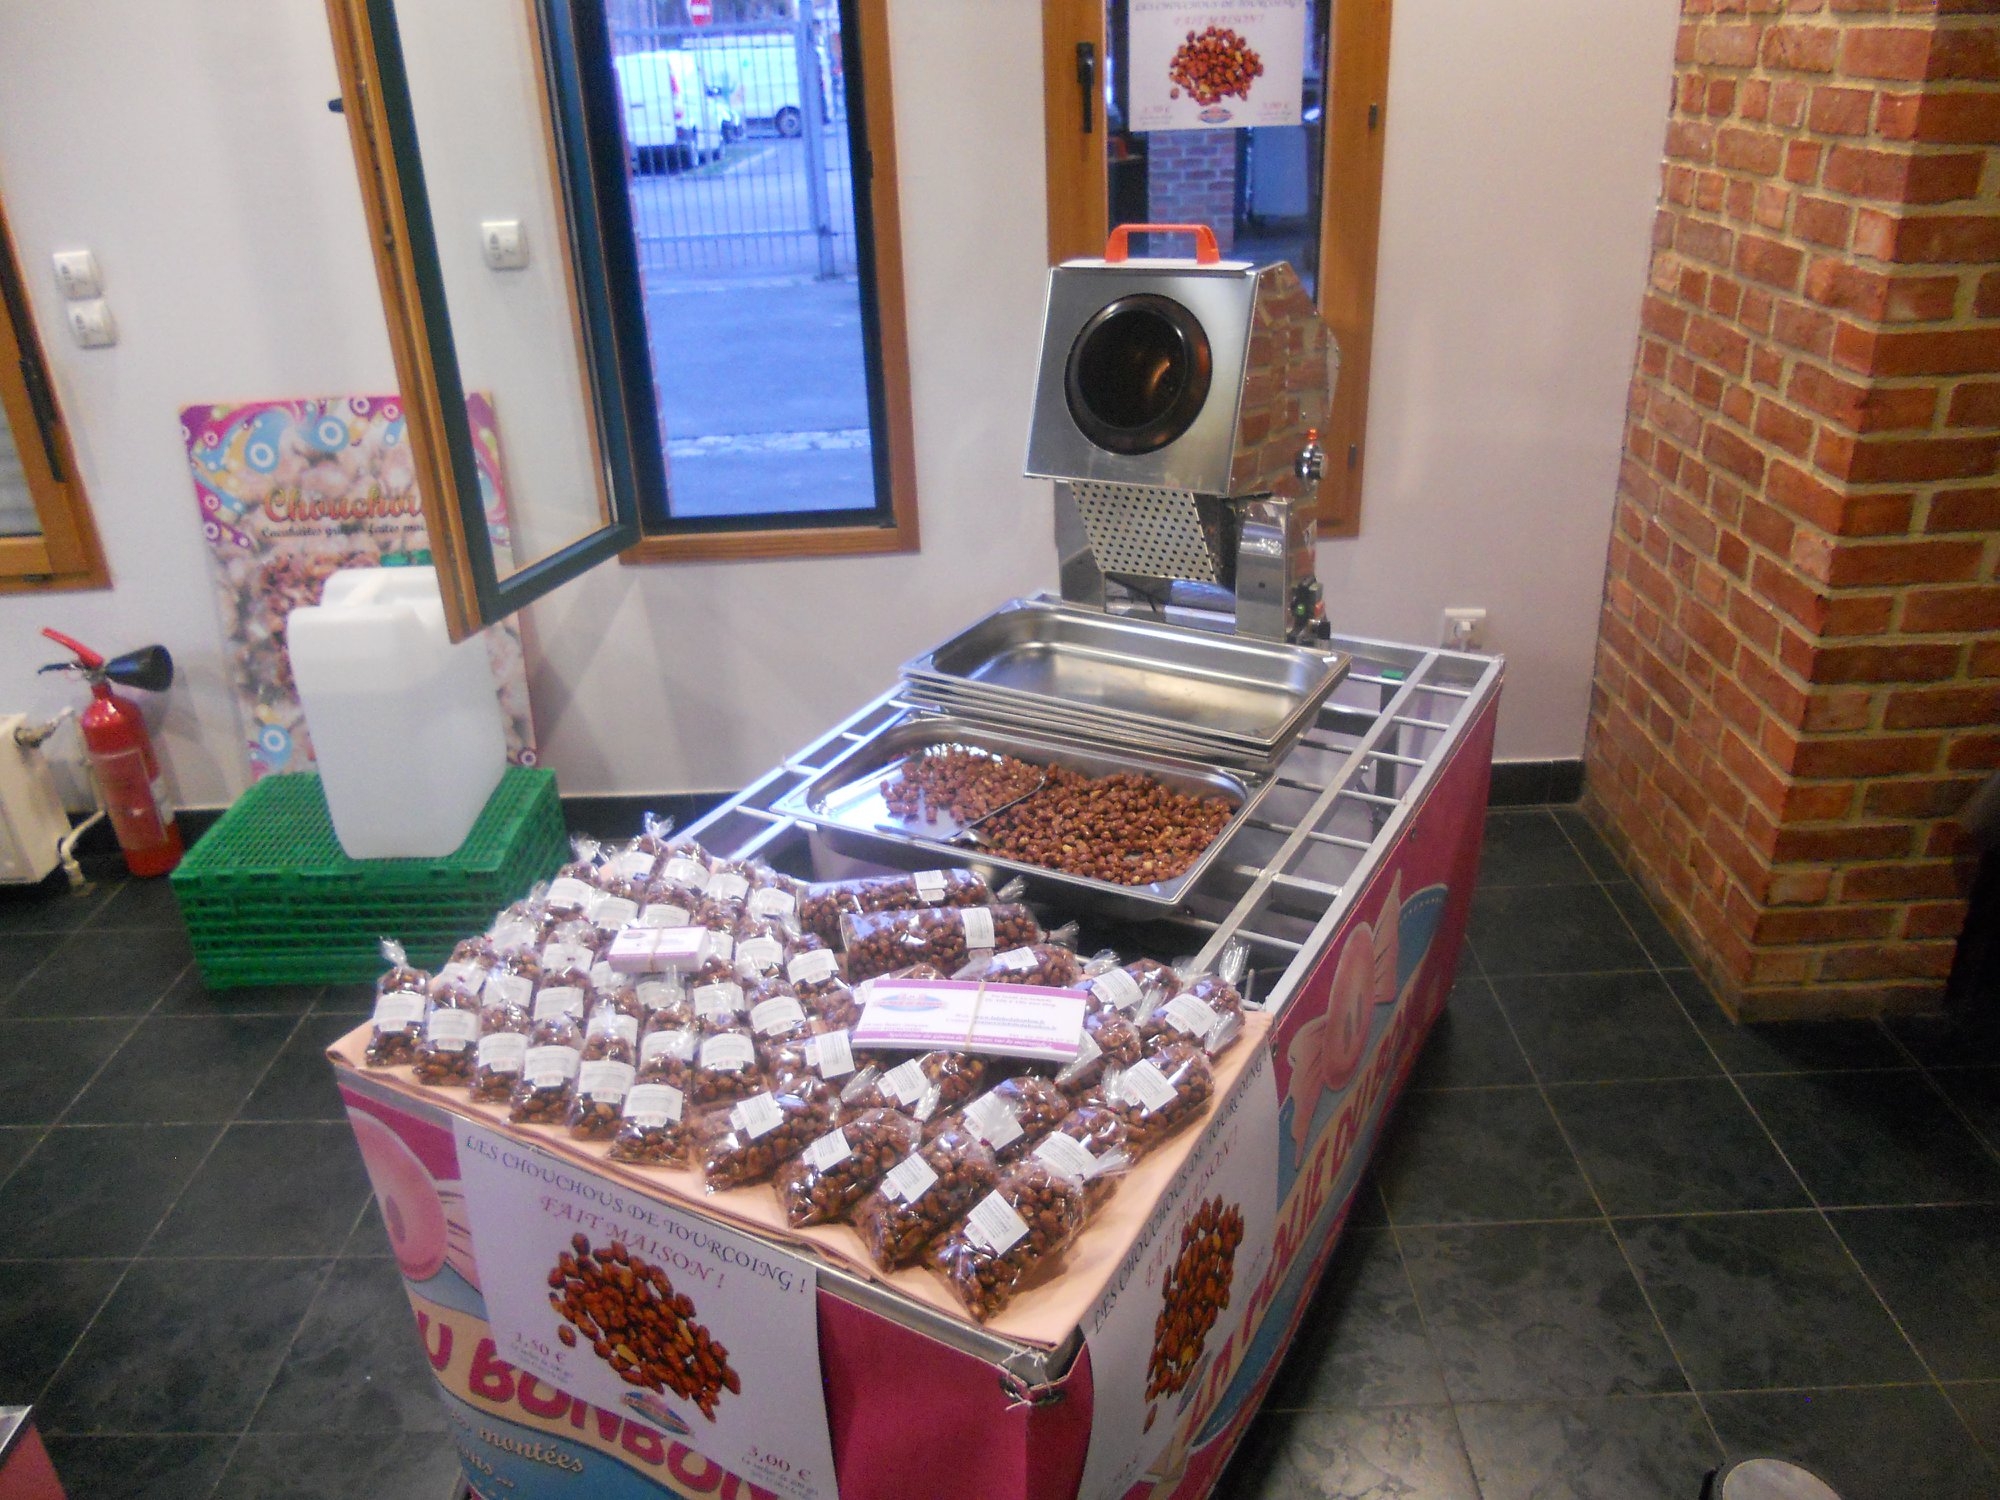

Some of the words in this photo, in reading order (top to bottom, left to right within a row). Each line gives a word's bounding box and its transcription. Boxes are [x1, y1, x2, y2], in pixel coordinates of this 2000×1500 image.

[264, 483, 424, 522] Chouchou
[465, 1135, 499, 1161] LES
[502, 1152, 625, 1213] CHOUCHOUS
[627, 1203, 660, 1228] DE
[663, 1219, 795, 1292] TOURCOING
[799, 1277, 807, 1294] !
[539, 1194, 605, 1231] FAIT
[605, 1220, 716, 1282] MAISON
[716, 1272, 726, 1290] !
[417, 1309, 454, 1373] U
